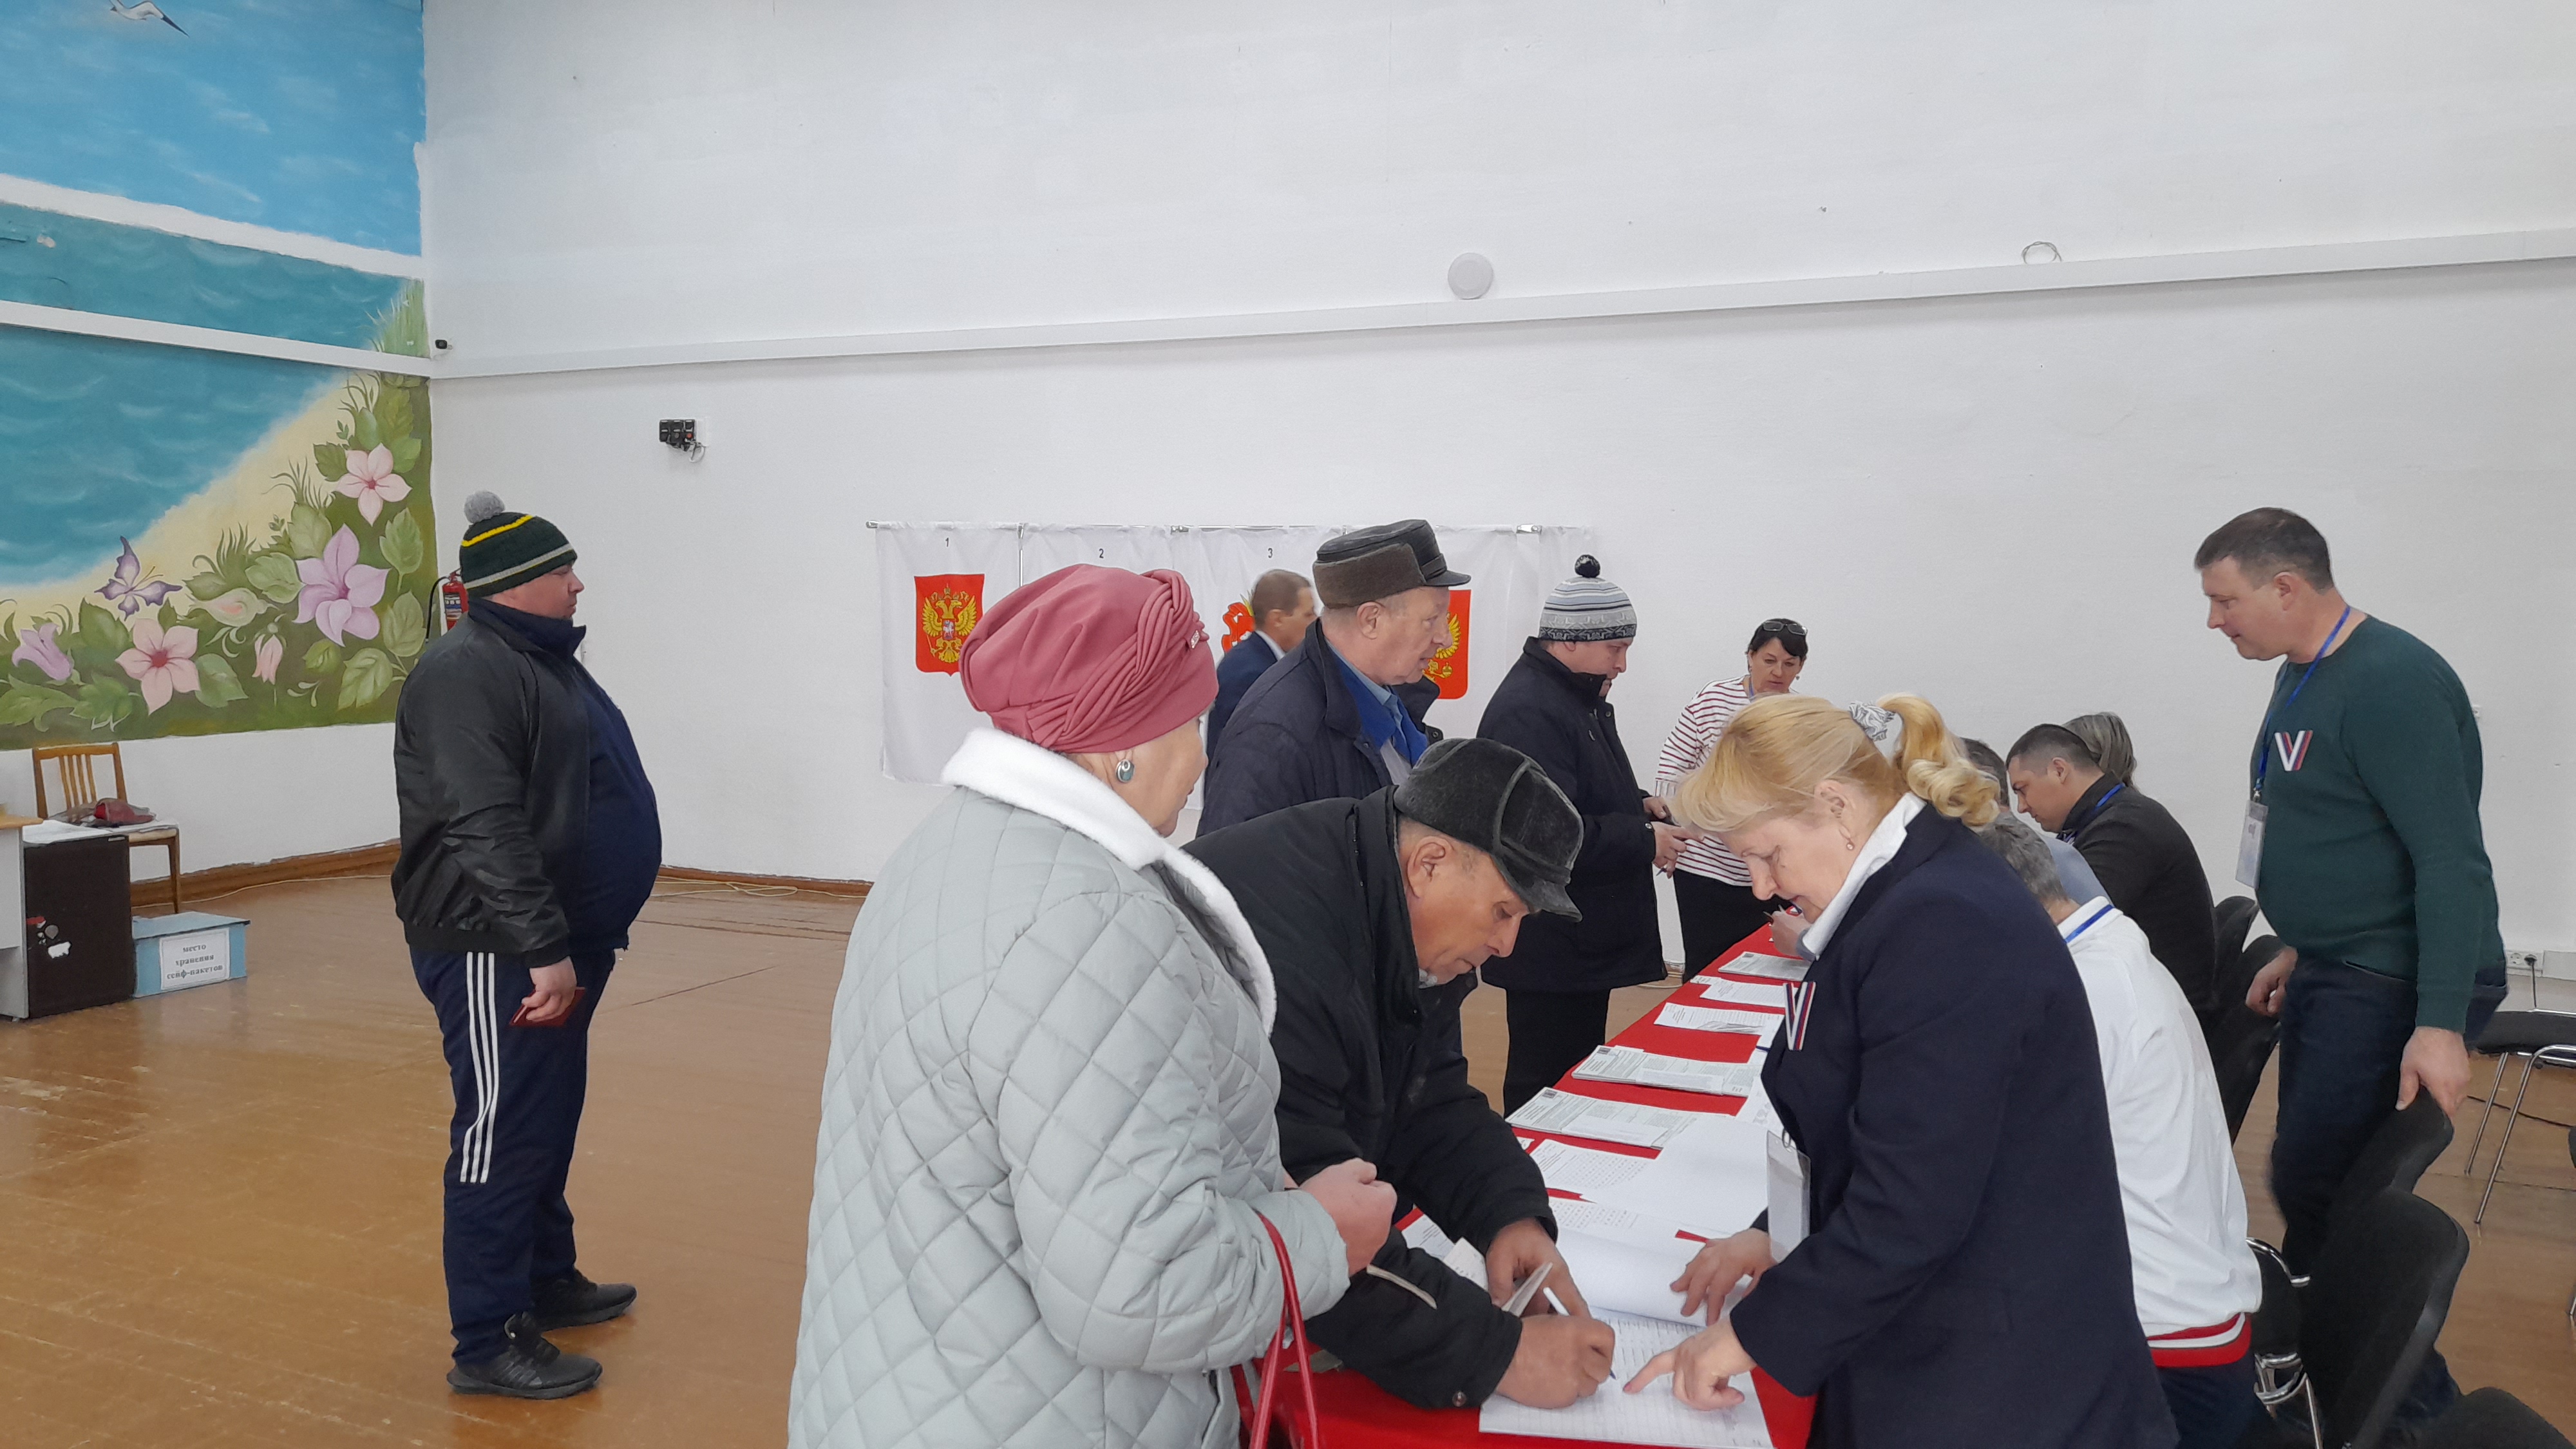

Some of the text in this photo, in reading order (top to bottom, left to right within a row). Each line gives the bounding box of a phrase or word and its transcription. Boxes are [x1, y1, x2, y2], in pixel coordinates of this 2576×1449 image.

[944, 536, 950, 547] 1
[1098, 547, 1104, 559] 2
[1267, 547, 1273, 558] 3
[182, 944, 207, 952] место
[175, 954, 214, 967] хранения
[166, 965, 223, 979] сейф-пакетов
